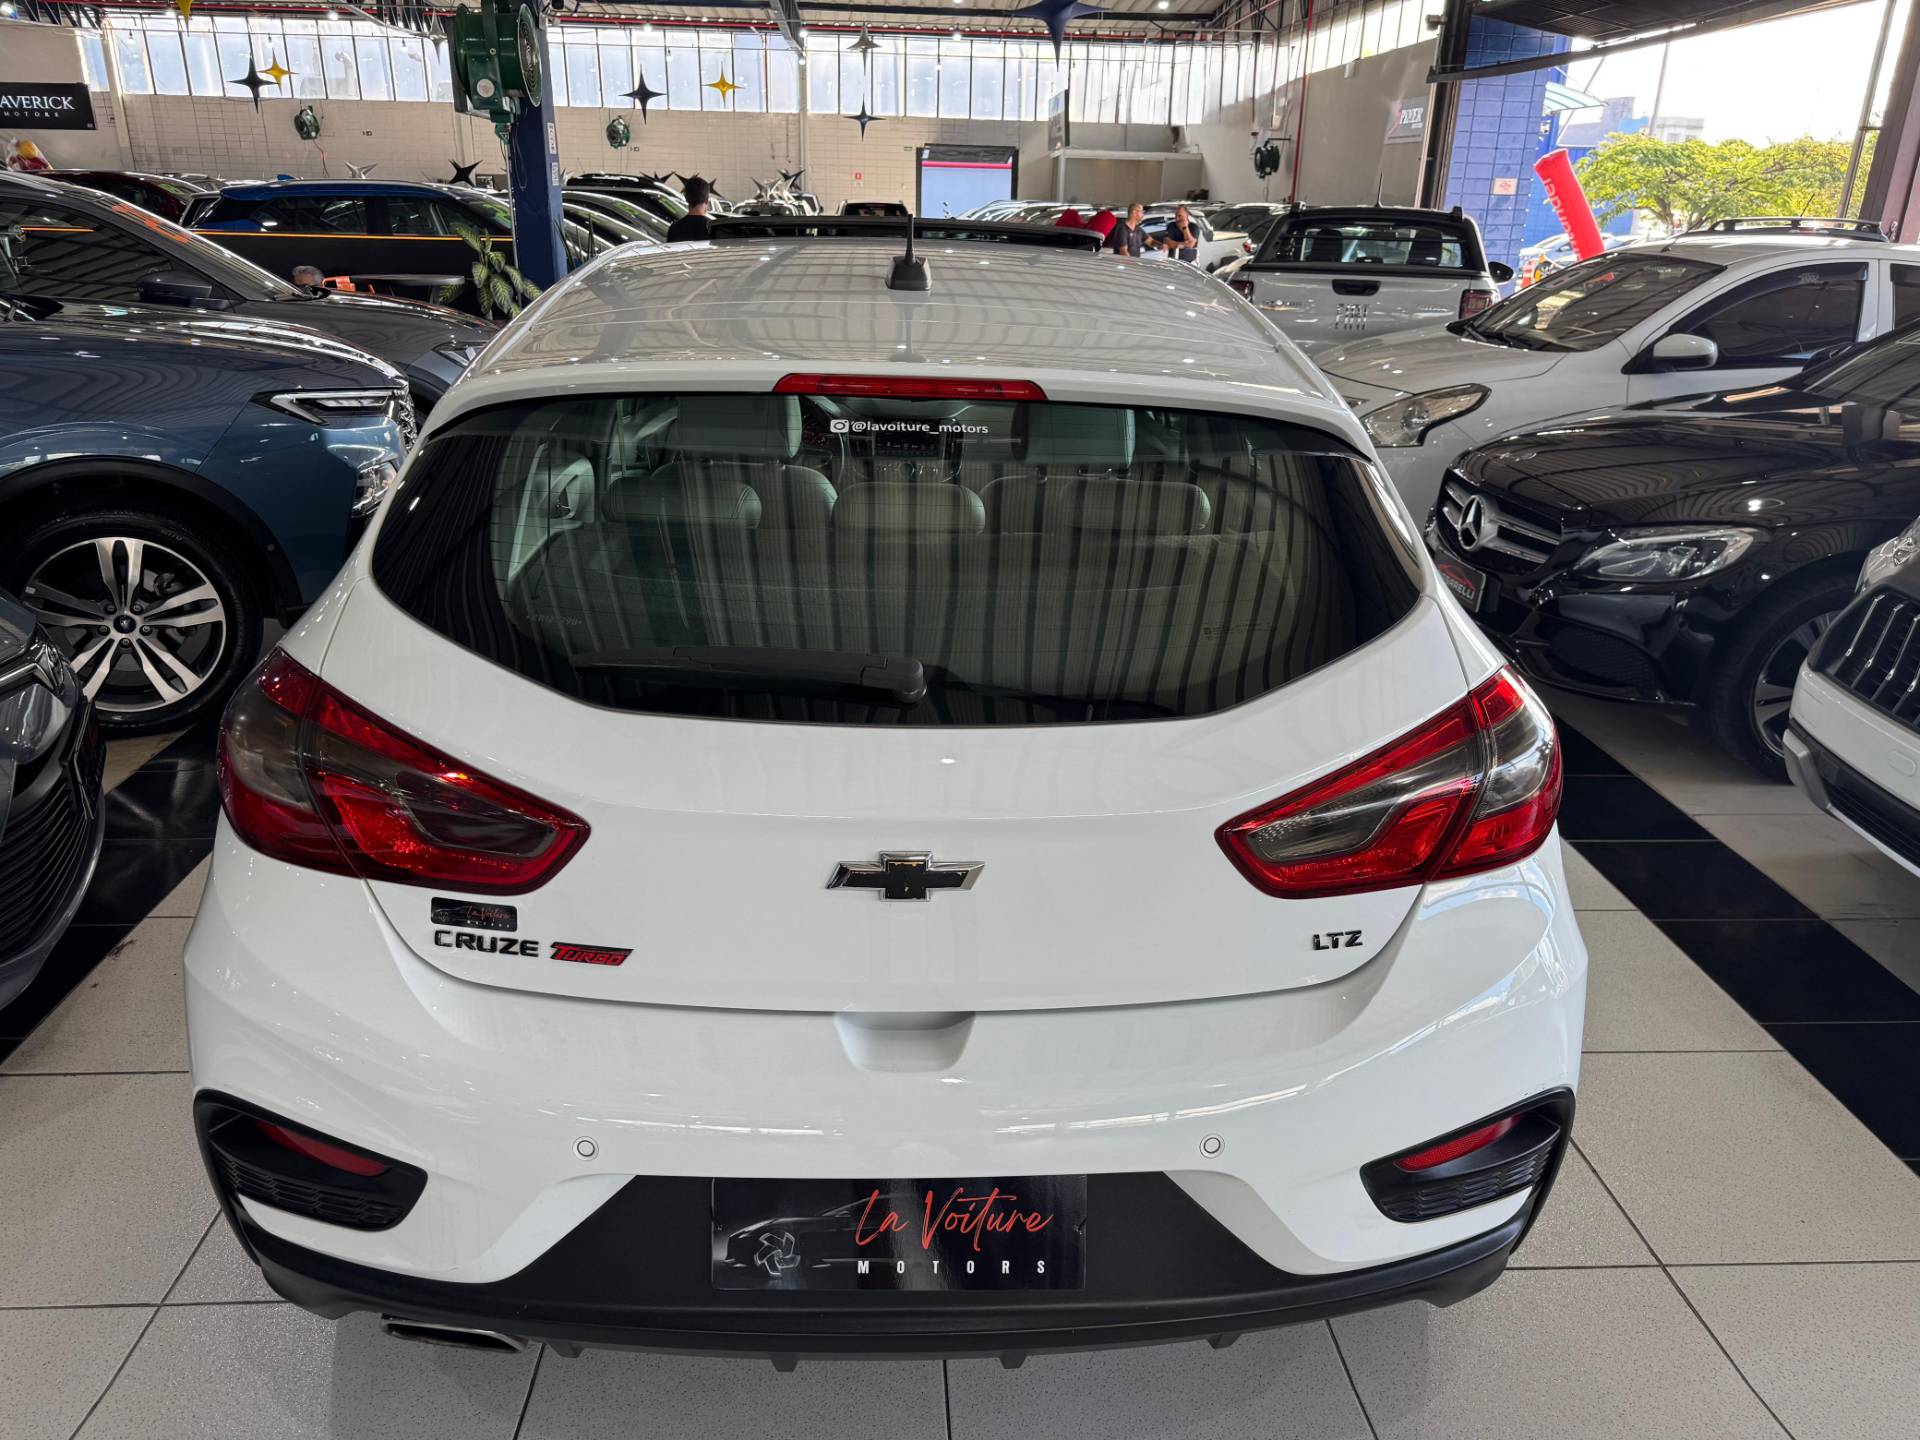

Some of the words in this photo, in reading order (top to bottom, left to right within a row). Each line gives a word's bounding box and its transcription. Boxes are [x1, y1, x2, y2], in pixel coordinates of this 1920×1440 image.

[0, 95, 76, 110] AVERICK
[851, 421, 989, 434] @lavoiture_motors
[434, 930, 540, 958] CRUZE
[554, 943, 626, 967] TURBO
[1312, 929, 1363, 951] LTZ
[855, 1188, 910, 1246] La
[921, 1186, 1054, 1252] Voiture
[856, 1259, 1046, 1275] MOTORS
